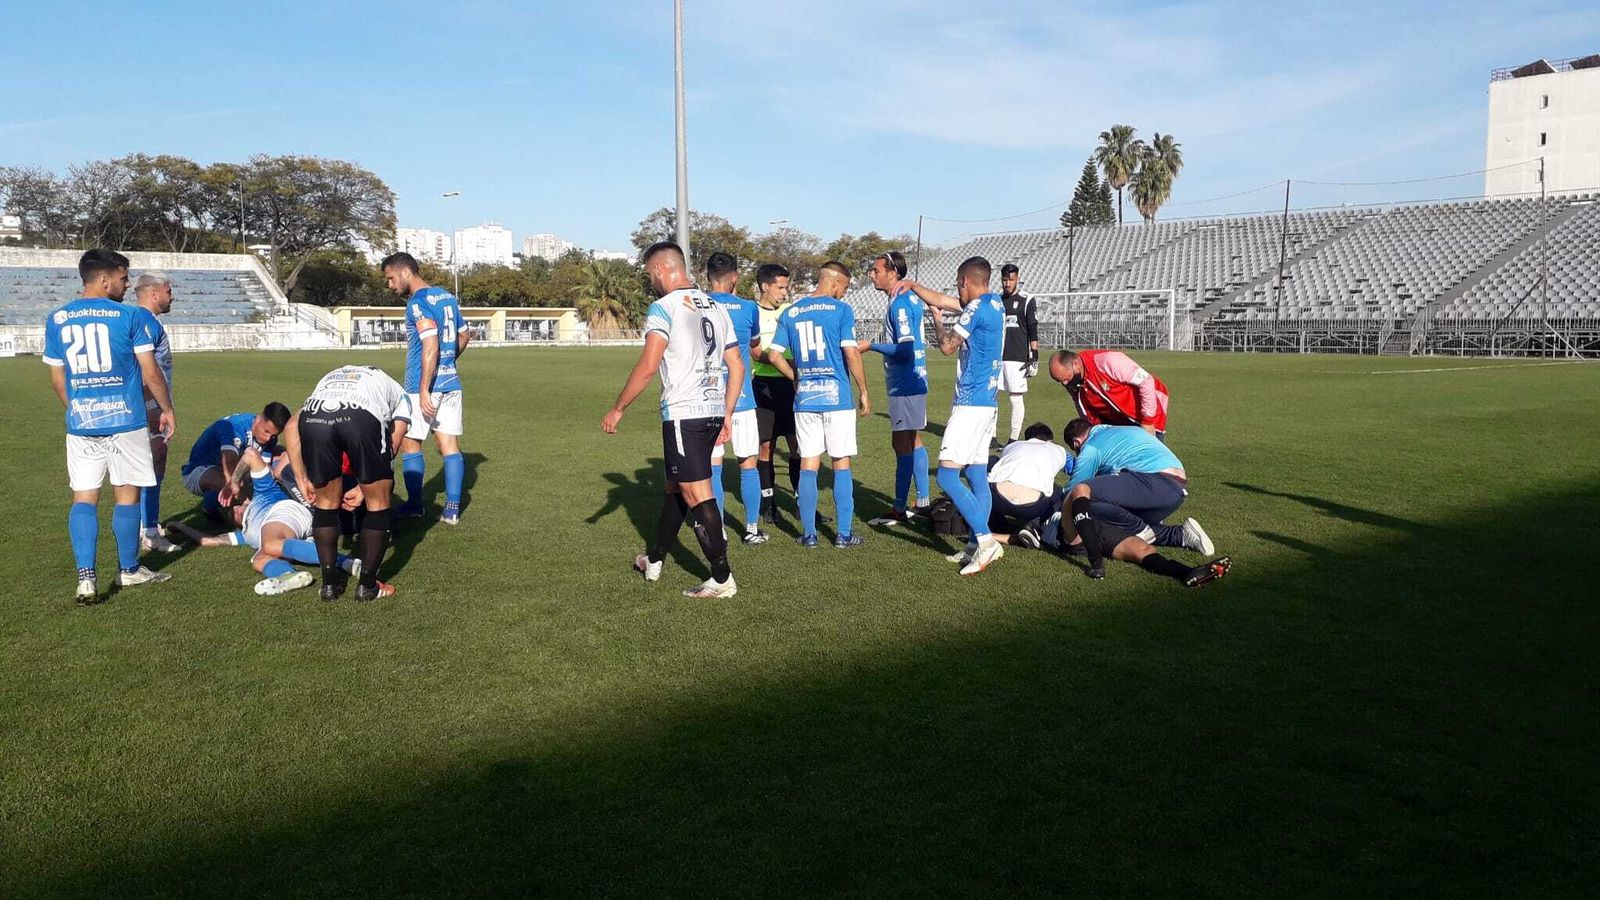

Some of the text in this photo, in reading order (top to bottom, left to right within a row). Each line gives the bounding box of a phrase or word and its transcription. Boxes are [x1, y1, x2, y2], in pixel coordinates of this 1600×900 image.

[68, 308, 120, 318] duokitchen
[443, 305, 456, 342] 5
[799, 303, 836, 314] duokitchen
[61, 322, 112, 375] 20
[700, 316, 717, 359] 9
[795, 321, 826, 362] 14
[77, 376, 123, 384] RUBYSAN
